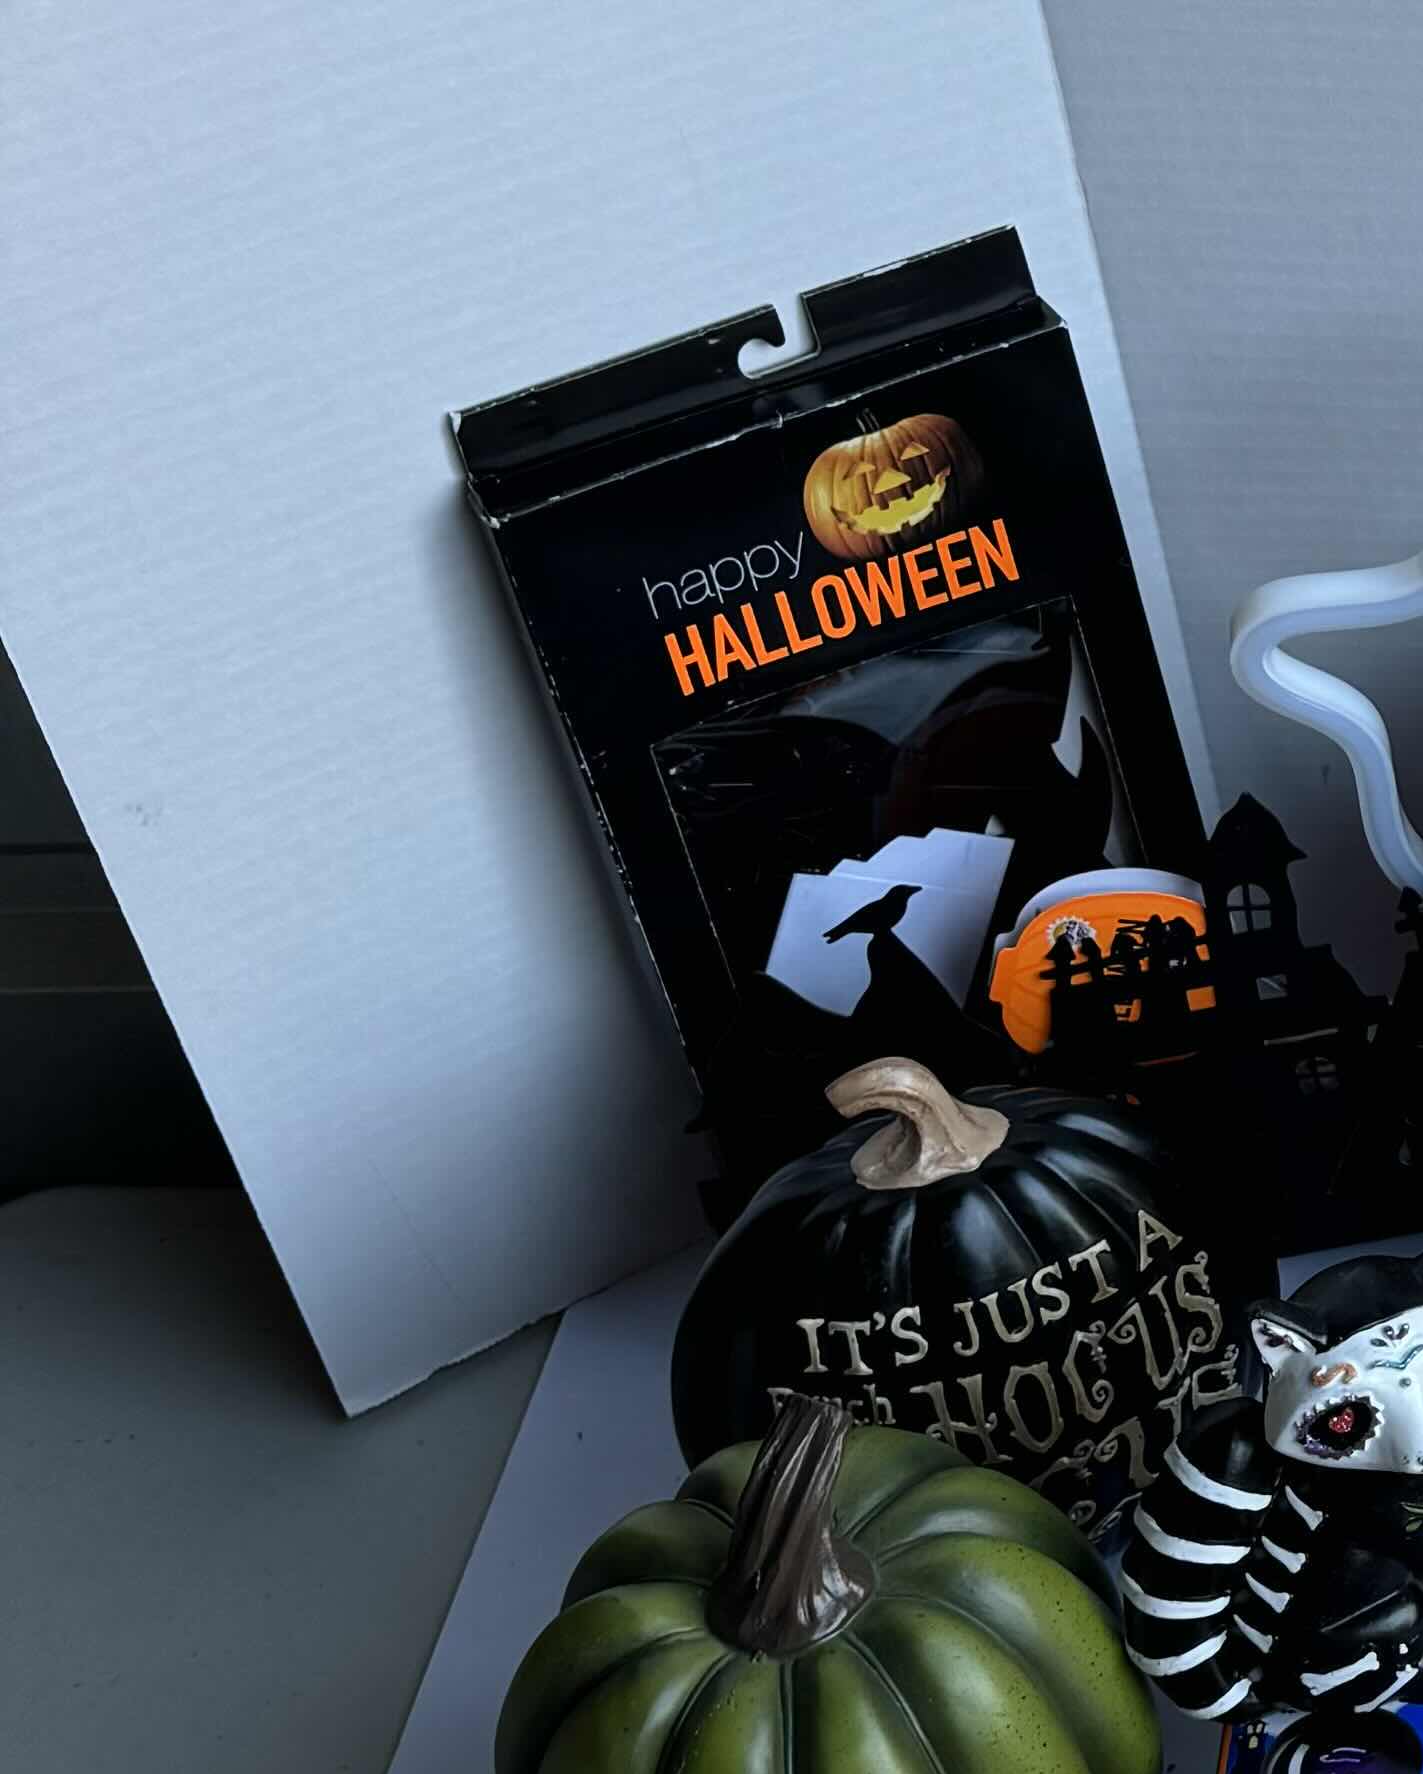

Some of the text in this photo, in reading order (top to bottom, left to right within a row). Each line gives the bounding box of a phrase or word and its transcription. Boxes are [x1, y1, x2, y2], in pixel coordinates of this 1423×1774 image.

[643, 533, 803, 620] happy
[663, 519, 1020, 696] HALLOWEEN
[796, 1209, 1183, 1375] IT'S JUST A
[910, 1251, 1224, 1464] HOCUS
